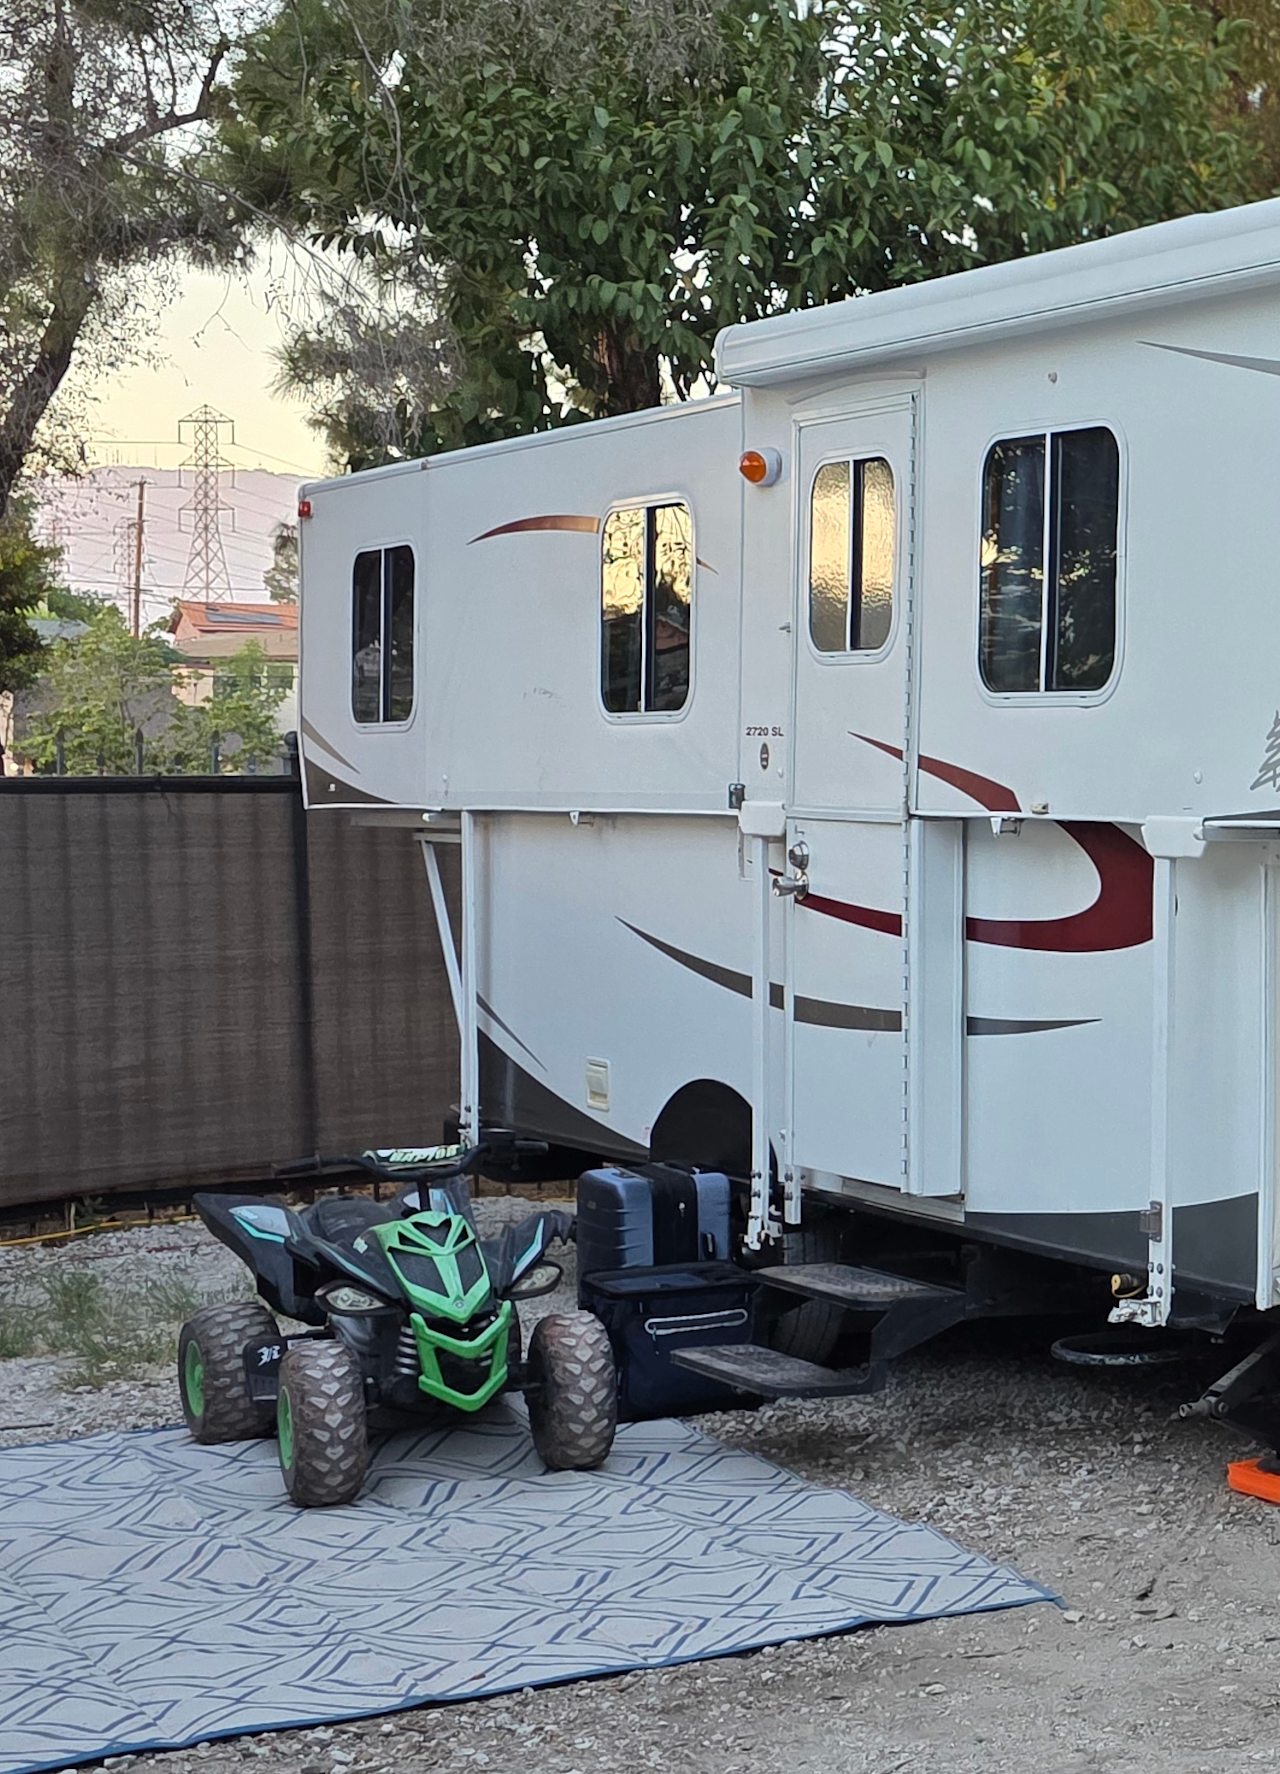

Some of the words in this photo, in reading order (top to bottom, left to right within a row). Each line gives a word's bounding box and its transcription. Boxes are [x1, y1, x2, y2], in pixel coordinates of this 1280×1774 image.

[745, 726, 769, 737] 2720
[771, 726, 784, 736] SL
[389, 1145, 461, 1163] RAPTOR
